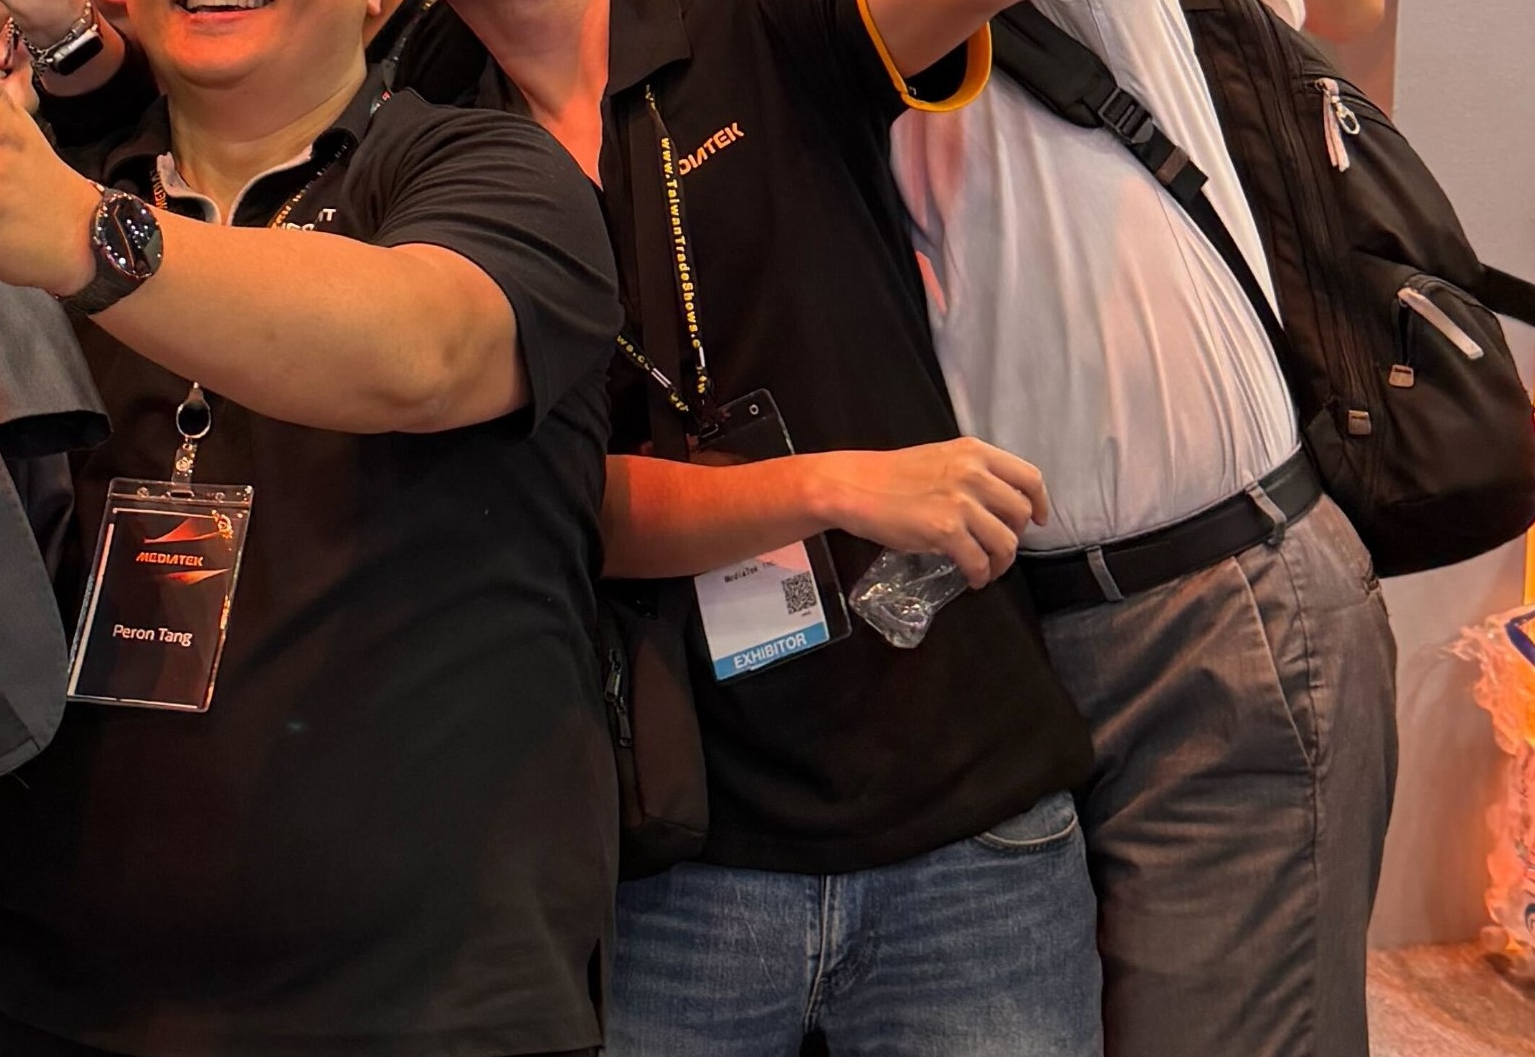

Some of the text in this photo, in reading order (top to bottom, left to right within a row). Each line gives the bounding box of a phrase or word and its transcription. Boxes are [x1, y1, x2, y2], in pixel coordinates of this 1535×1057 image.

[678, 122, 745, 176] DIATEK
[135, 552, 204, 567] MEDIATEK
[112, 624, 193, 647] Peron Tang
[733, 632, 808, 670] EXHIBITOR
